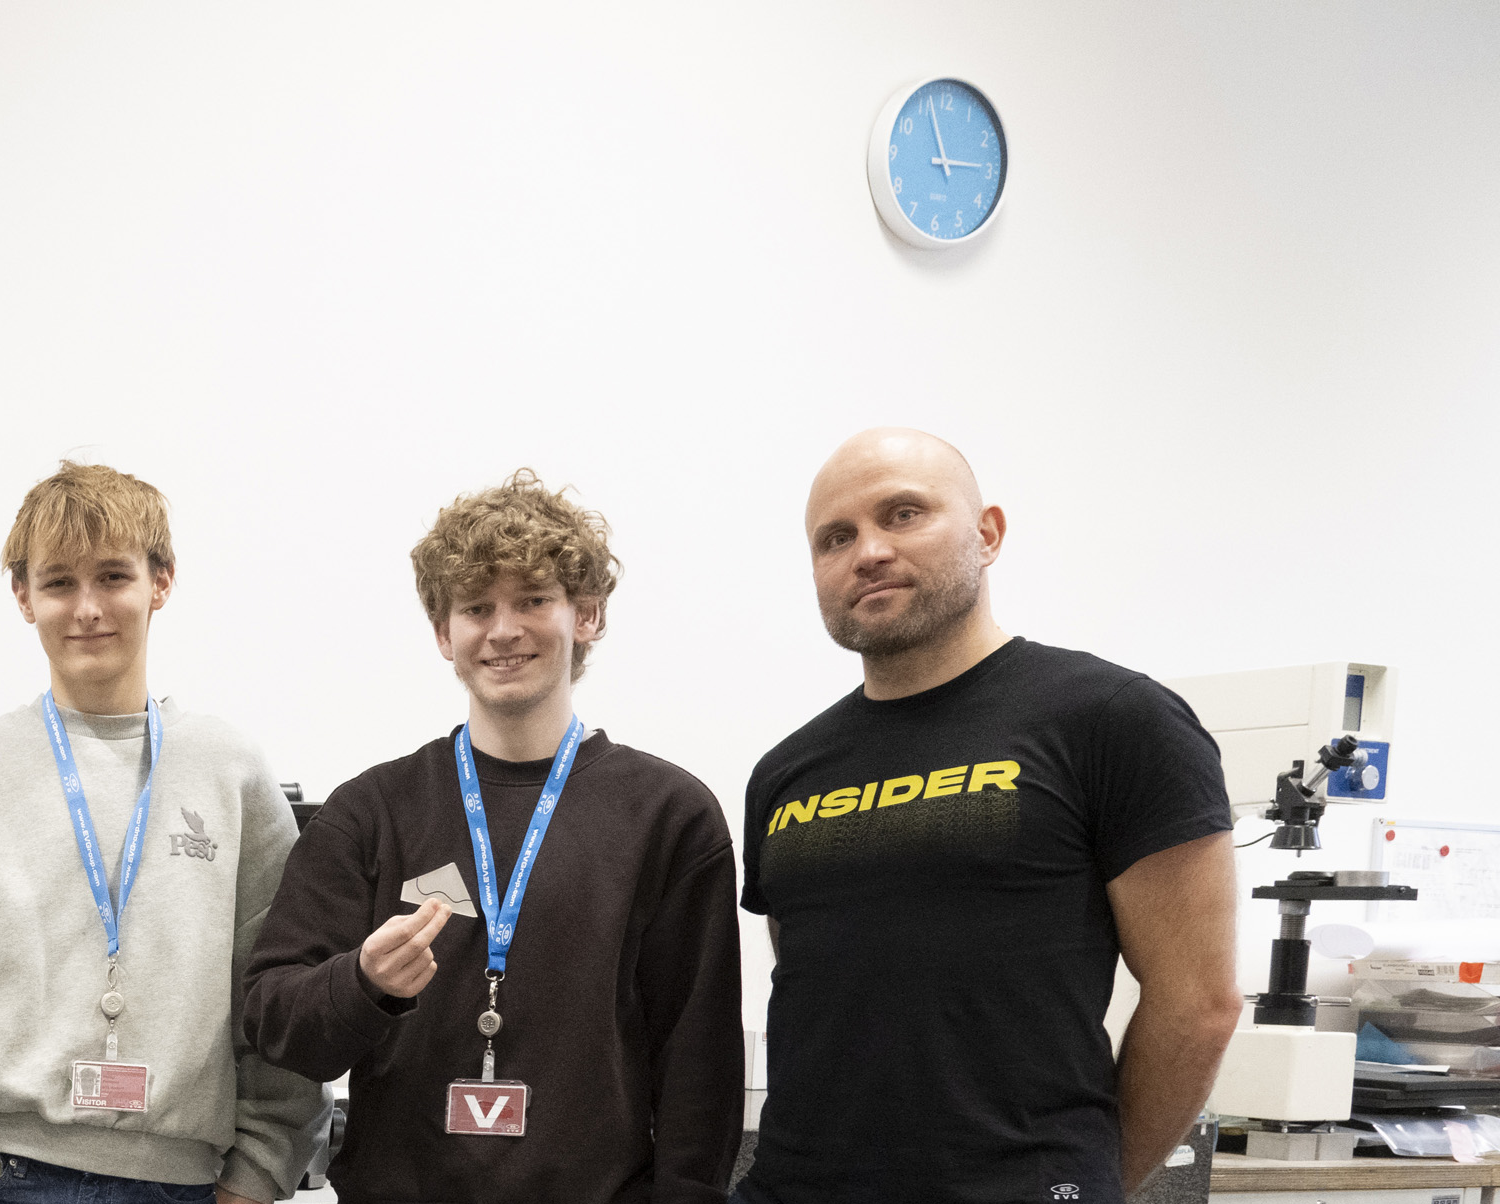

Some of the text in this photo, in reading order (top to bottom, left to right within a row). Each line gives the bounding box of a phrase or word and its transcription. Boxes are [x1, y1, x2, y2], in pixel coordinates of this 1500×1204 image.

[940, 93, 953, 111] 12
[899, 117, 913, 135] 10
[980, 130, 989, 148] 2
[889, 144, 898, 161] 9
[985, 162, 993, 180] 3
[893, 177, 902, 194] 8
[910, 201, 918, 218] 7
[973, 192, 982, 209] 4
[930, 214, 940, 231] 6
[955, 210, 963, 227] 5
[767, 760, 1021, 837] INSIDER
[77, 808, 100, 887] www.EVGroup.com
[123, 807, 143, 885] www.EVGroup.com
[476, 827, 493, 906] www.EVGroup.com
[509, 828, 539, 907] www.EVGroup.com
[75, 1096, 107, 1106] VISITOR
[463, 1094, 510, 1128] V
